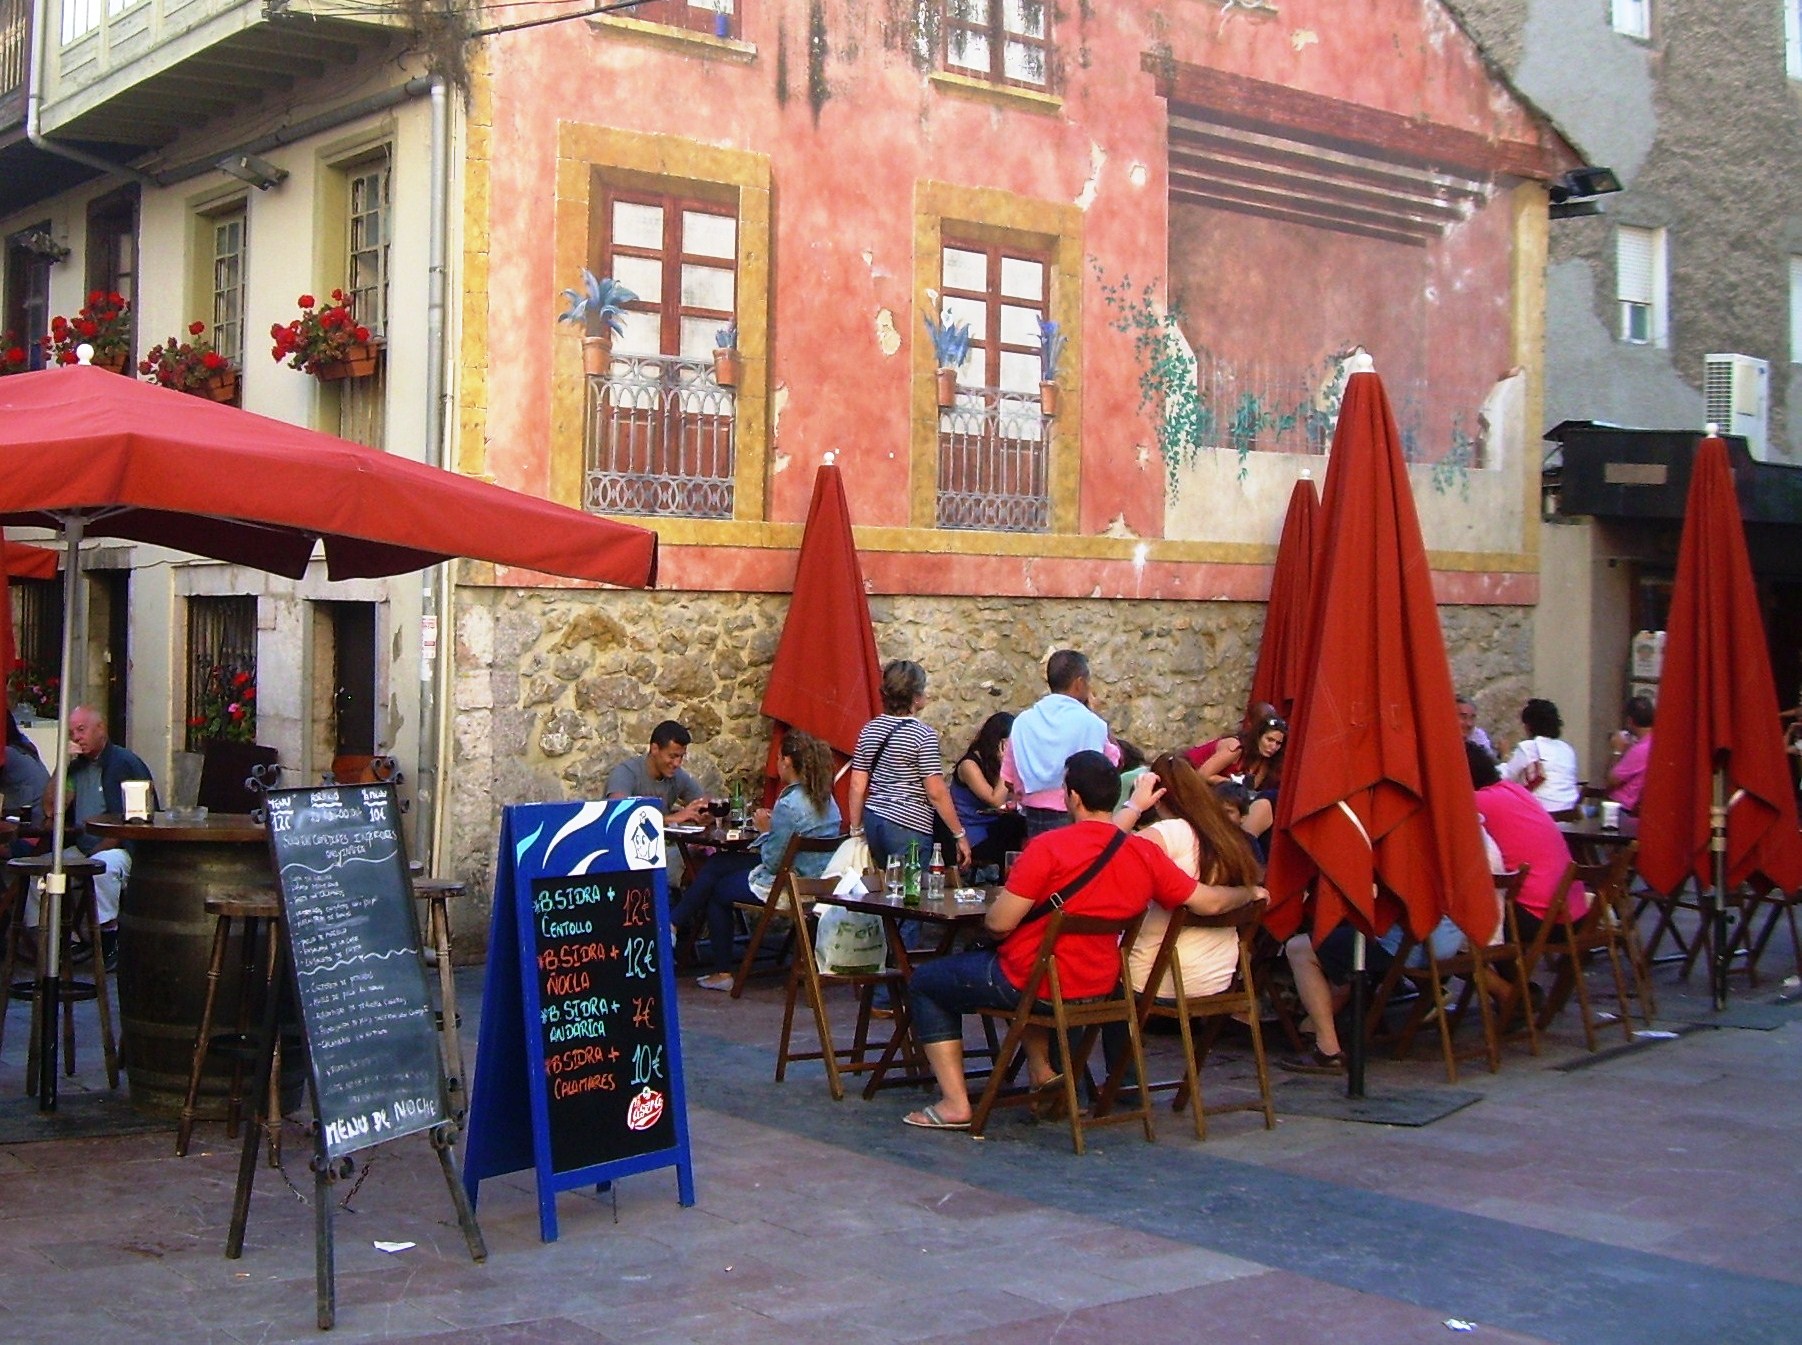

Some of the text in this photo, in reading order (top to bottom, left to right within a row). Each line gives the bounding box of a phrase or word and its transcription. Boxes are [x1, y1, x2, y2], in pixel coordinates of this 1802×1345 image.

[541, 915, 593, 938] CENTOLLO
[622, 888, 651, 926] 12€
[623, 937, 656, 979] 12€
[630, 1044, 664, 1085] 10€
